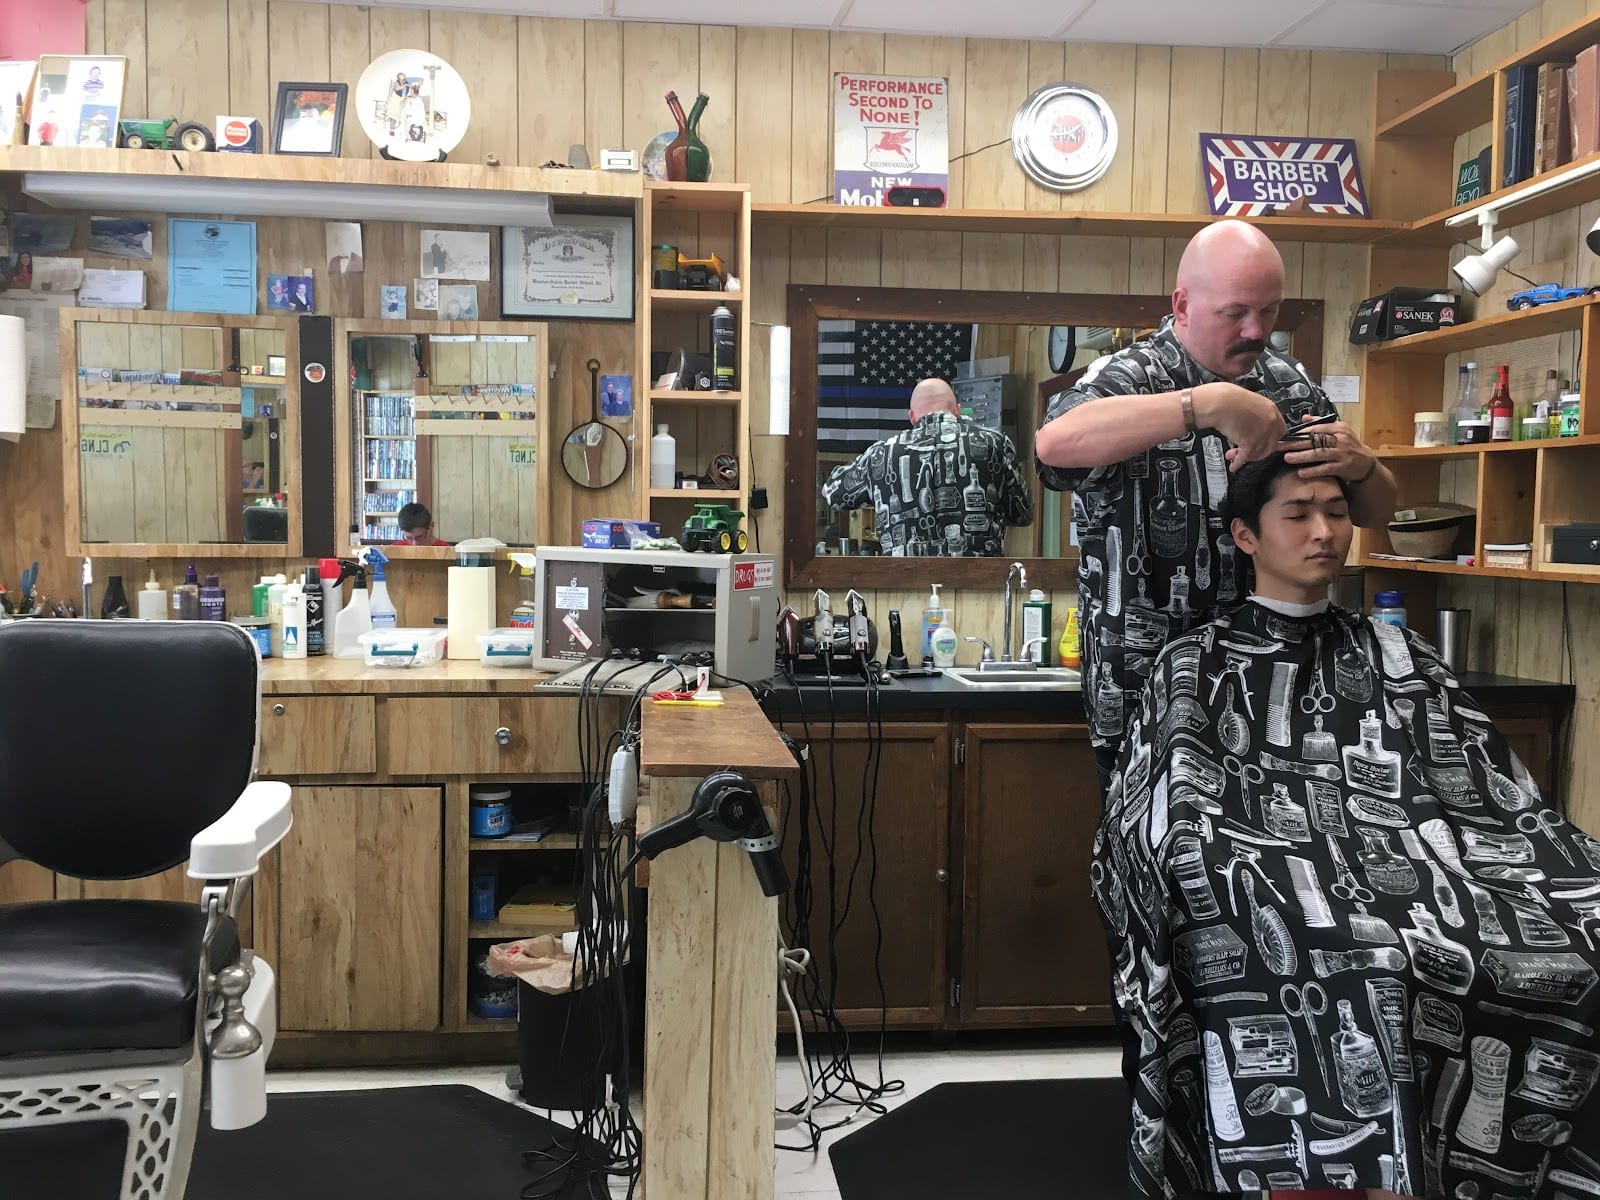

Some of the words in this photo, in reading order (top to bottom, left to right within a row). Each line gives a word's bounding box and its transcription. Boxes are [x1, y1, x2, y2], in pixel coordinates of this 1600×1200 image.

[840, 76, 944, 95] PERFORMANCE
[848, 92, 909, 109] SECOND
[1233, 160, 1329, 183] BARBER
[871, 176, 912, 188] NEW
[1253, 181, 1318, 201] SHOP
[1402, 311, 1434, 320] SANEK
